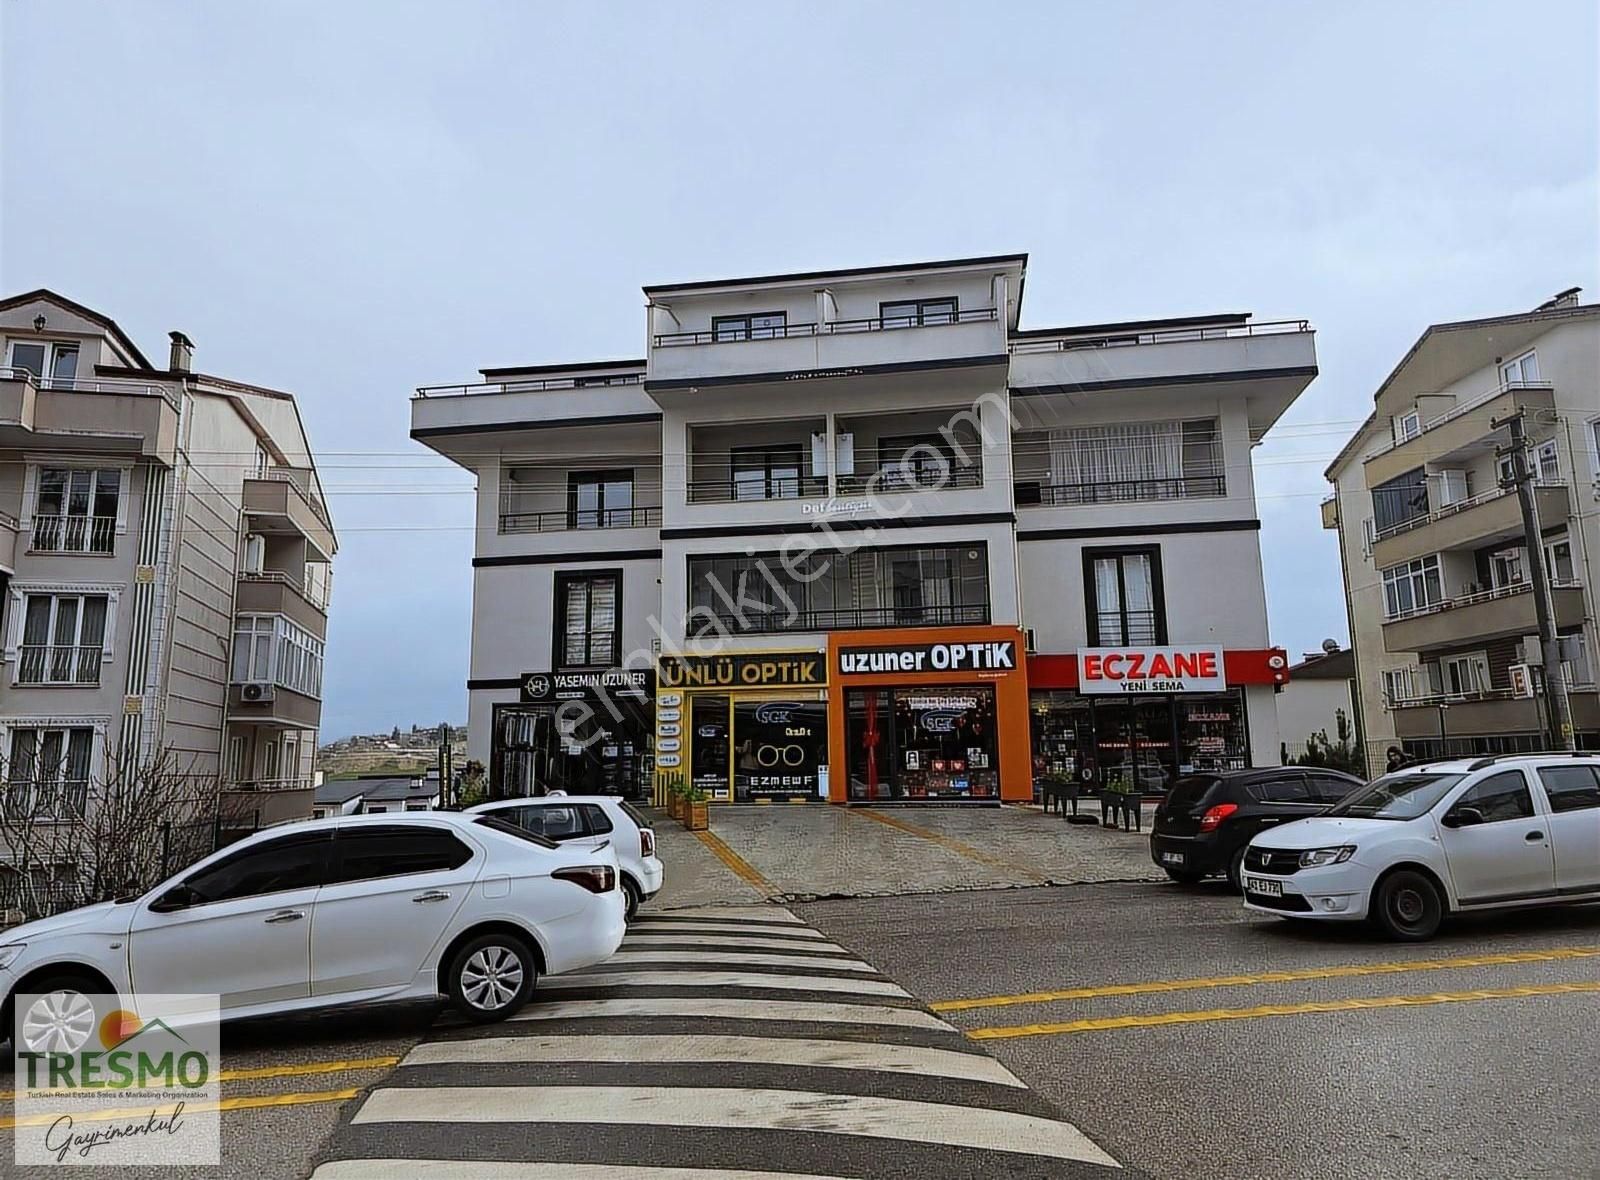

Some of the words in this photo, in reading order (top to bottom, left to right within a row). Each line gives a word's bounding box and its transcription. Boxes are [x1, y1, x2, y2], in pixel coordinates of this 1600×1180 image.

[840, 650, 926, 673] uzuner
[1084, 652, 1218, 681] ECZANE
[601, 672, 646, 686] UZUNER
[667, 658, 733, 685] ÜNLÜ
[1152, 681, 1185, 691] SEMA
[761, 711, 792, 724] SGK
